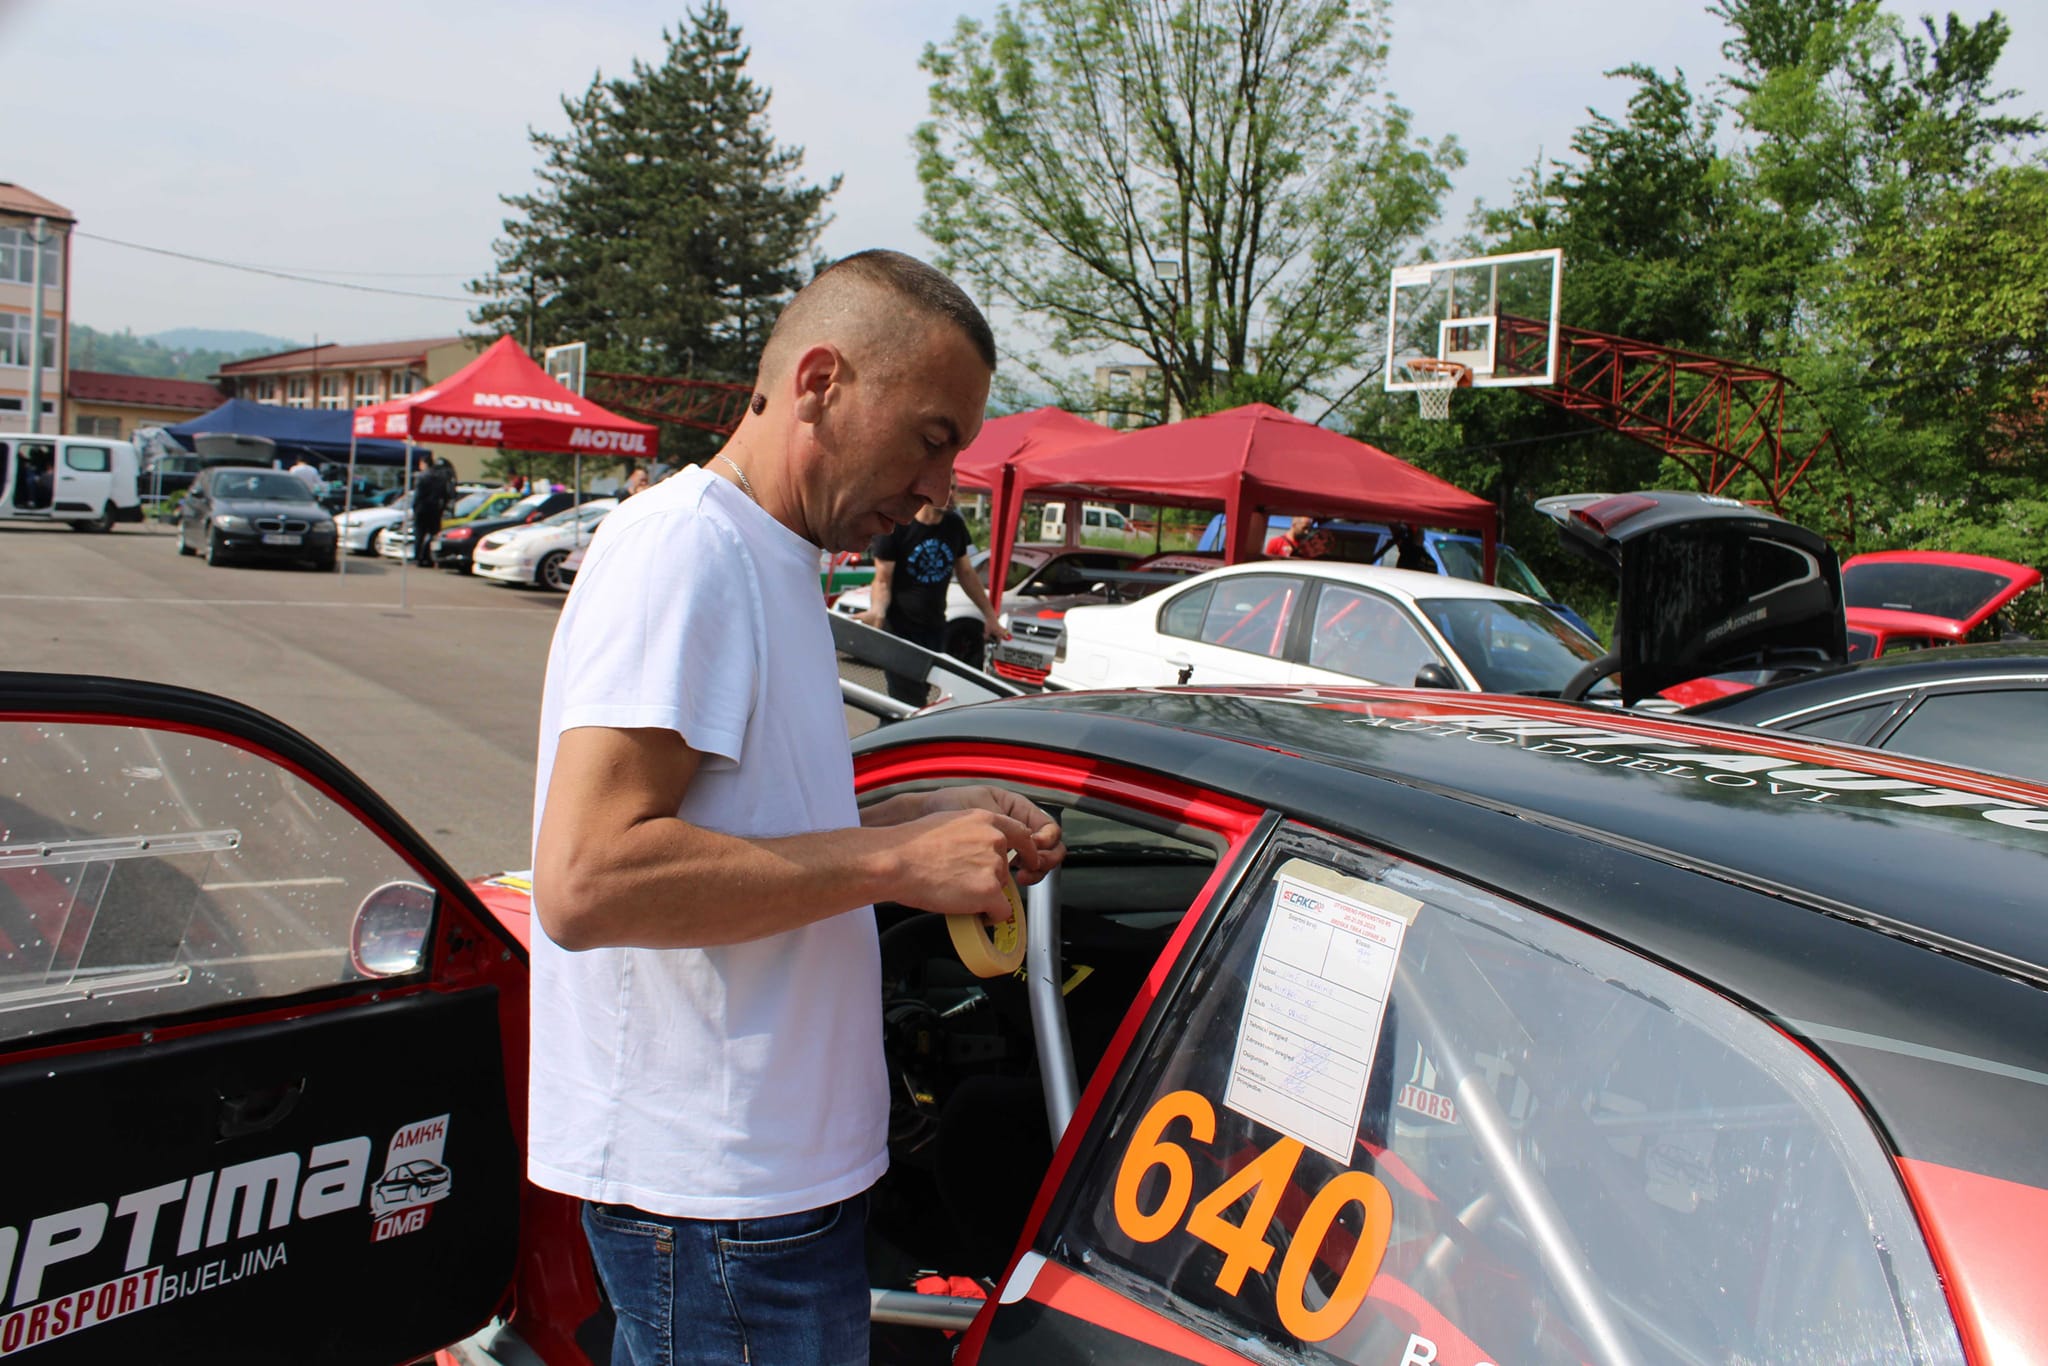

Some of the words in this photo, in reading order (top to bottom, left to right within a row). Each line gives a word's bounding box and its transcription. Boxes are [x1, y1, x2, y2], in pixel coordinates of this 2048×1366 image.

[419, 413, 504, 439] MOTUL
[473, 392, 581, 416] MOTUL
[569, 427, 647, 452] MOTUL
[1343, 718, 1515, 744] AUTO
[1522, 742, 1840, 803] DIJELOVI
[393, 1120, 444, 1151] AMKK
[1114, 1090, 1393, 1342] 640
[160, 1242, 287, 1304] BIJELJINA
[0, 1268, 161, 1355] ORSPORT
